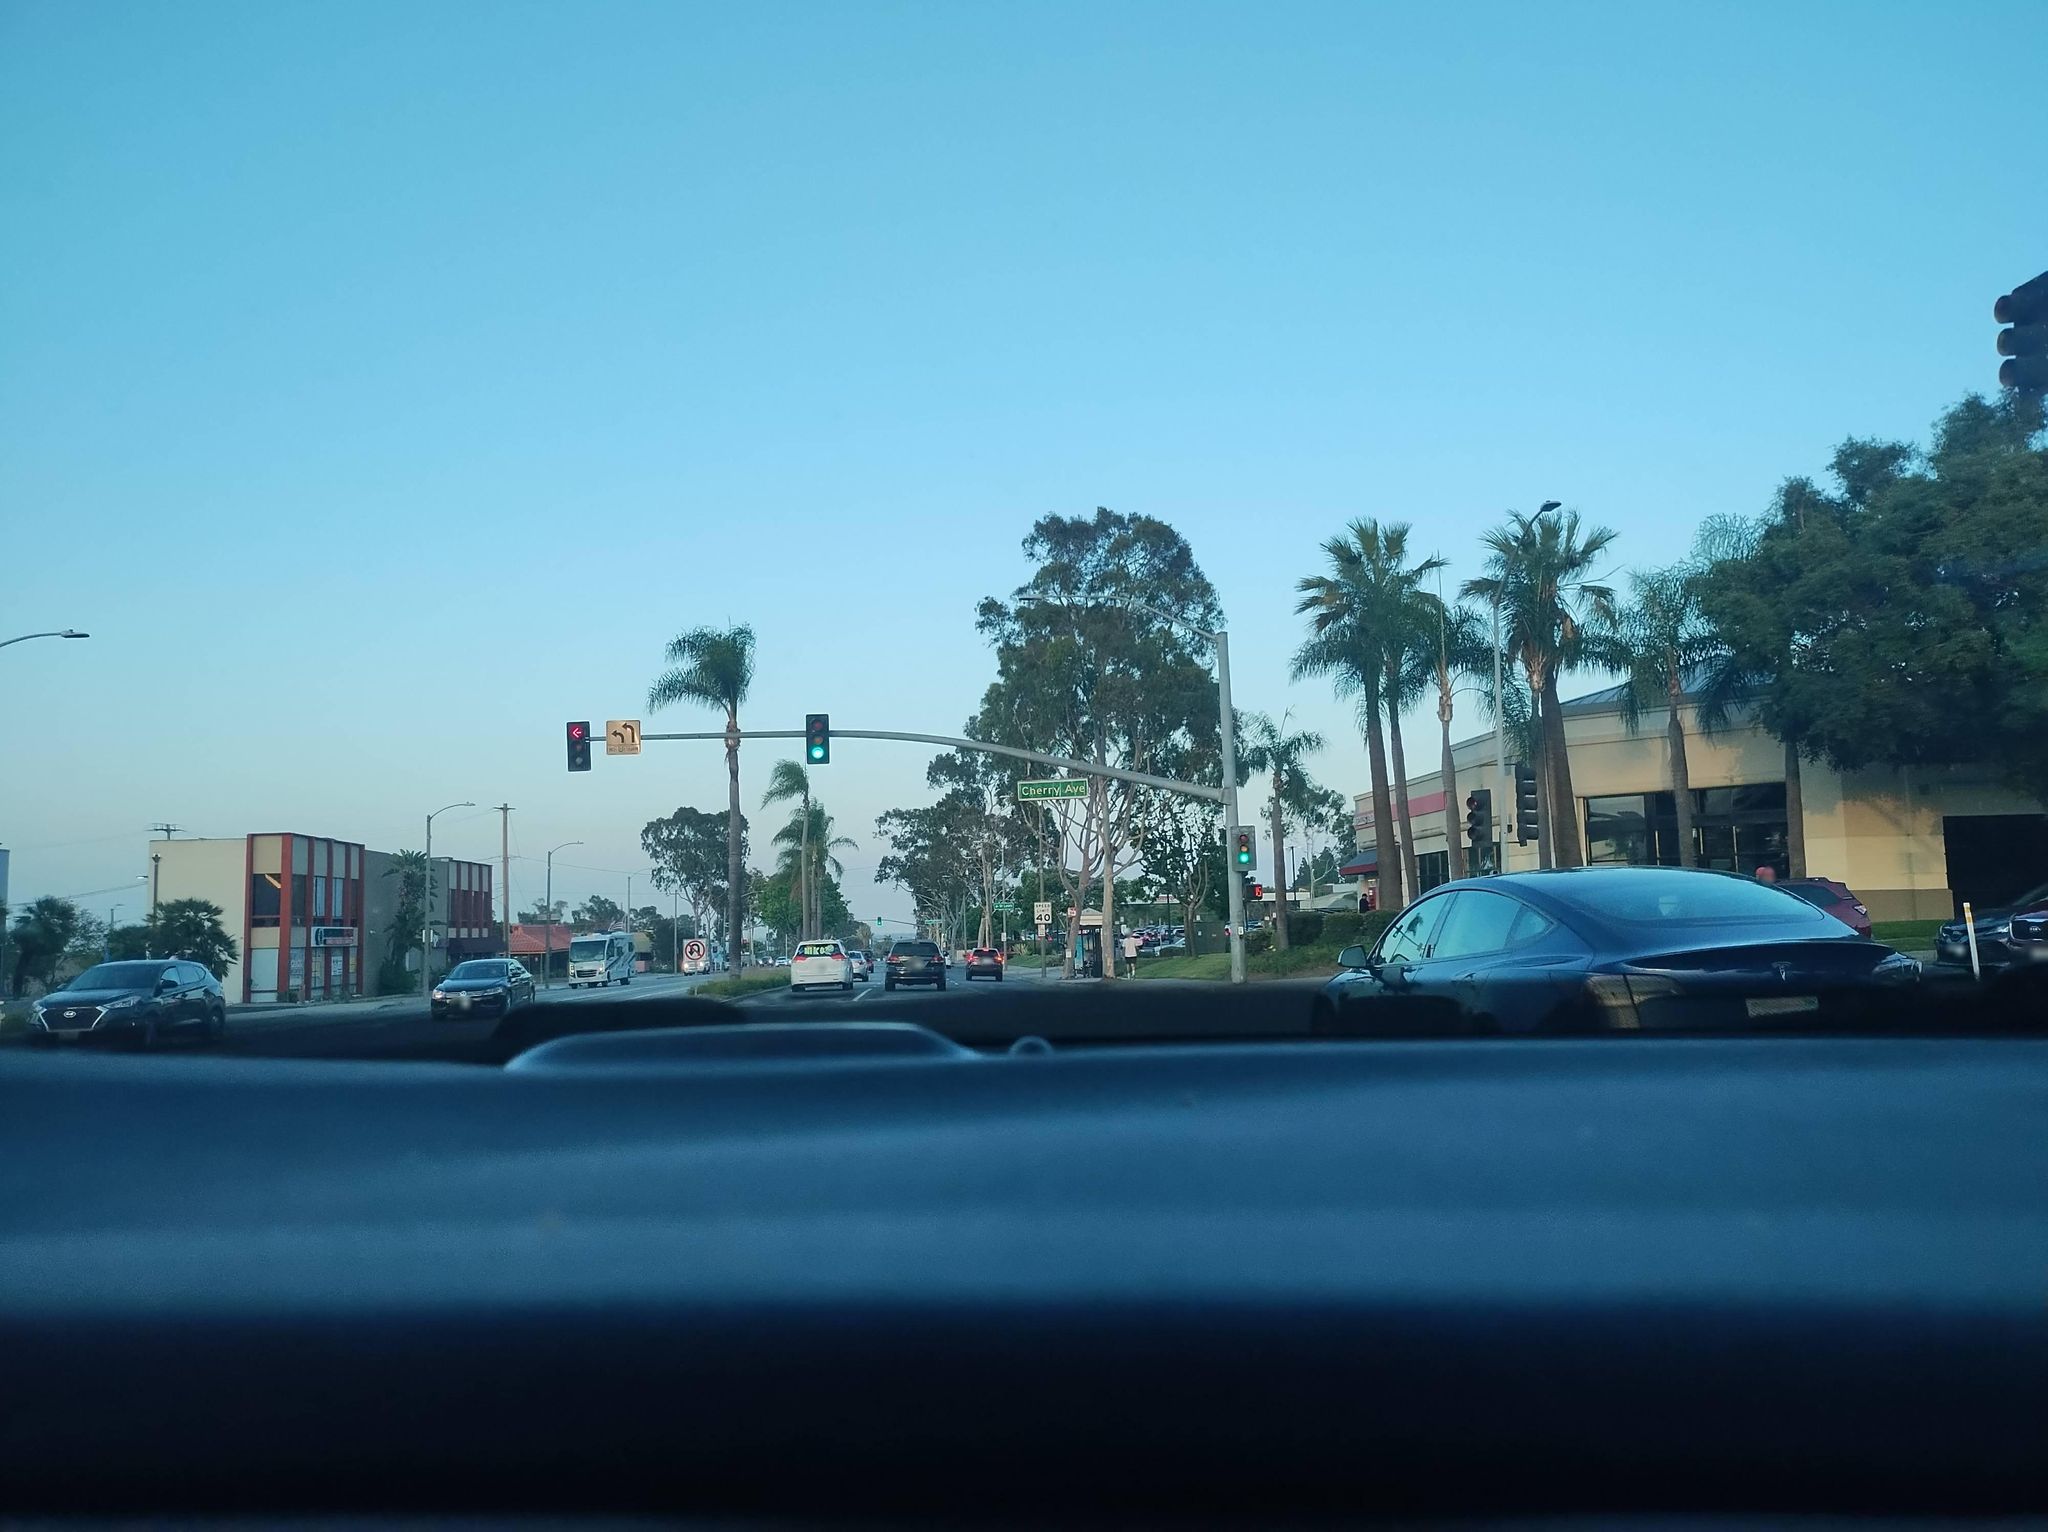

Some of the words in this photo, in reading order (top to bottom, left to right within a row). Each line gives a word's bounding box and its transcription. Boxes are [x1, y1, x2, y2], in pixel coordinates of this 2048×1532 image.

[1021, 786, 1060, 796] Cherry
[1064, 784, 1085, 794] Ave
[1036, 913, 1050, 921] 40
